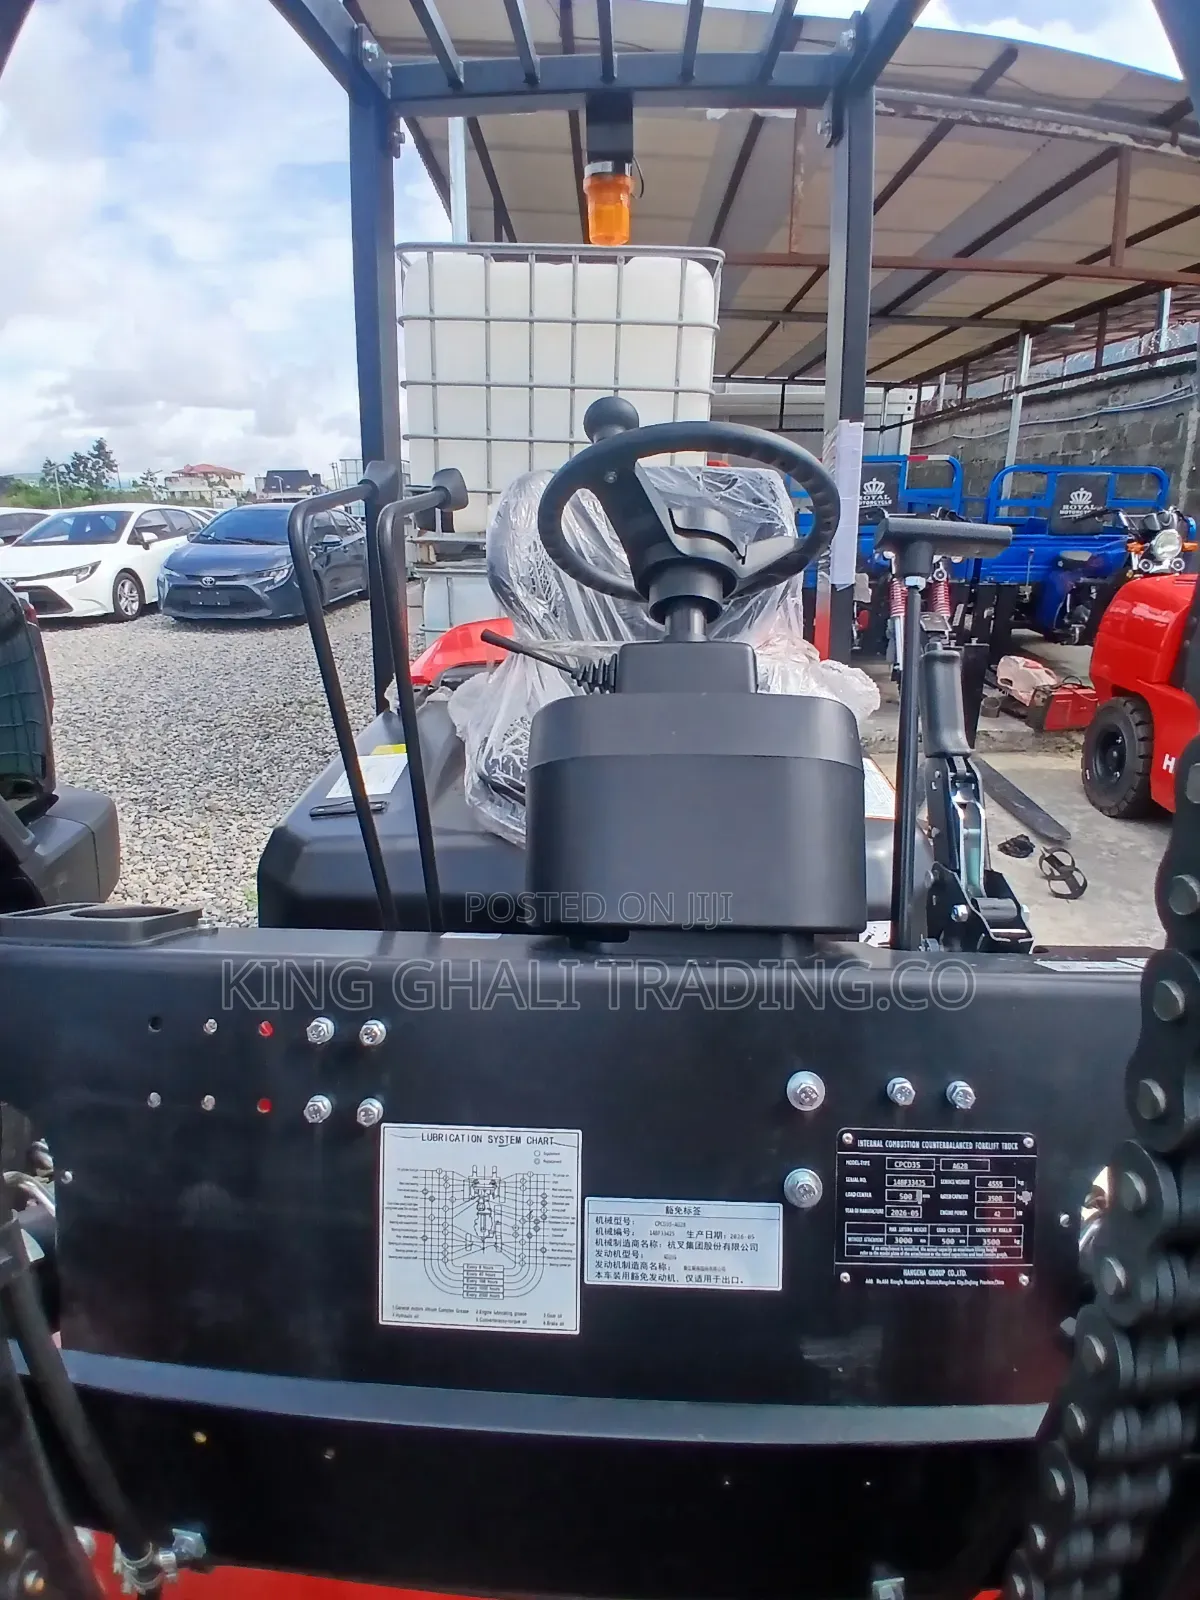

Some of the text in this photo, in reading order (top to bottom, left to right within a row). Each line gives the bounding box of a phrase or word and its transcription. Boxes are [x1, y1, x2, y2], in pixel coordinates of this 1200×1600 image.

[421, 1132, 555, 1146] LUBRICATION SYSTEM CHART
[857, 1139, 1019, 1150] INTERNAL COMBUSTION COUNTERBALANCED FORKLIFT TRUCK
[894, 1160, 921, 1169] CPCD35
[899, 1192, 913, 1200] 500
[665, 1205, 702, 1215] 豁免标签
[890, 1208, 920, 1217] 2026-05
[894, 1236, 914, 1244] 3000
[982, 1238, 1001, 1246] 3500
[902, 1269, 927, 1277] HANGCHA
[928, 1269, 946, 1277] GROUP
